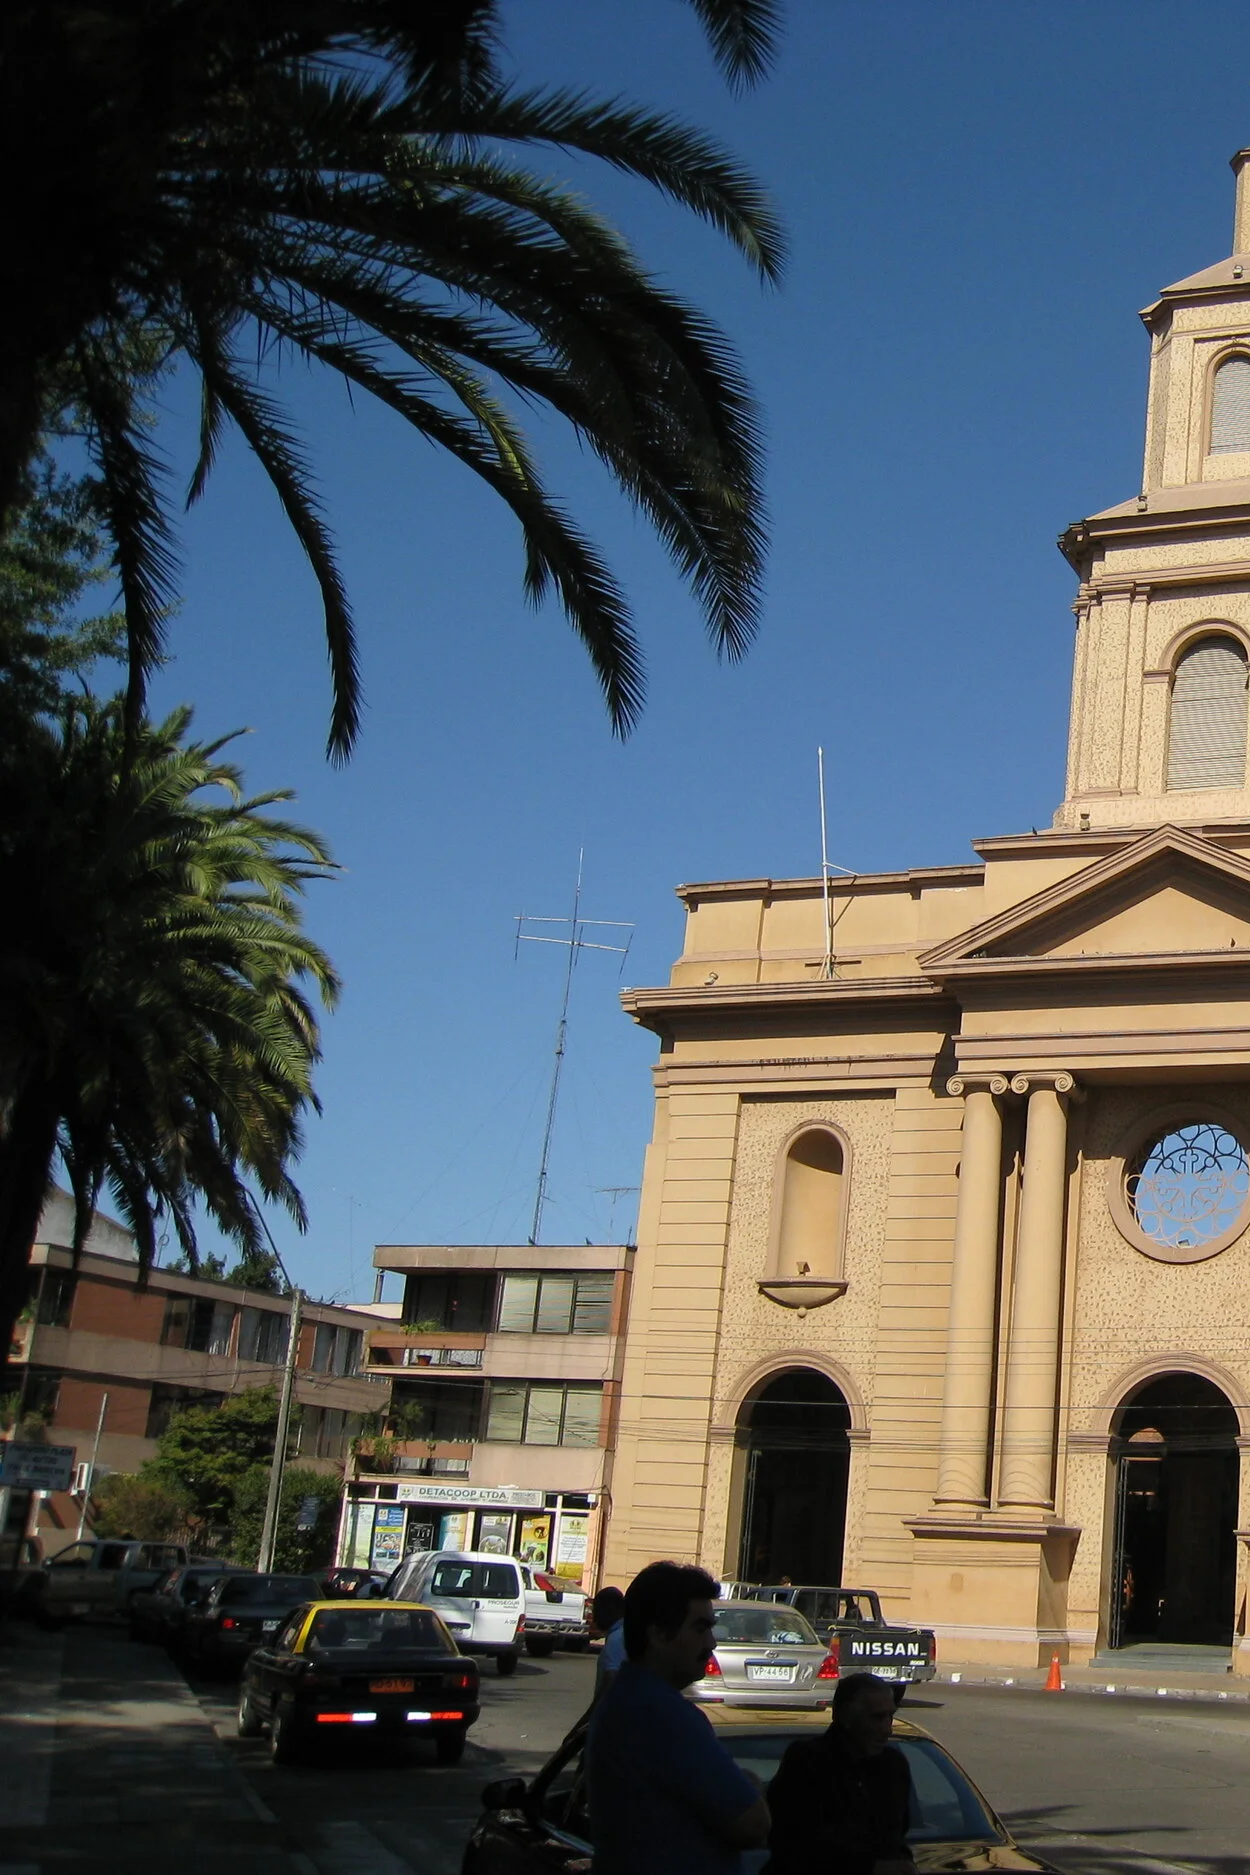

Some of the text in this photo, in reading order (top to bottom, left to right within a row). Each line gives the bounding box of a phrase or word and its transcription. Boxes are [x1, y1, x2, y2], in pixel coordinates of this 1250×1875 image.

[419, 1487, 477, 1498] DETACOOP
[480, 1491, 509, 1500] LTDA.
[852, 1642, 919, 1655] NISSAN
